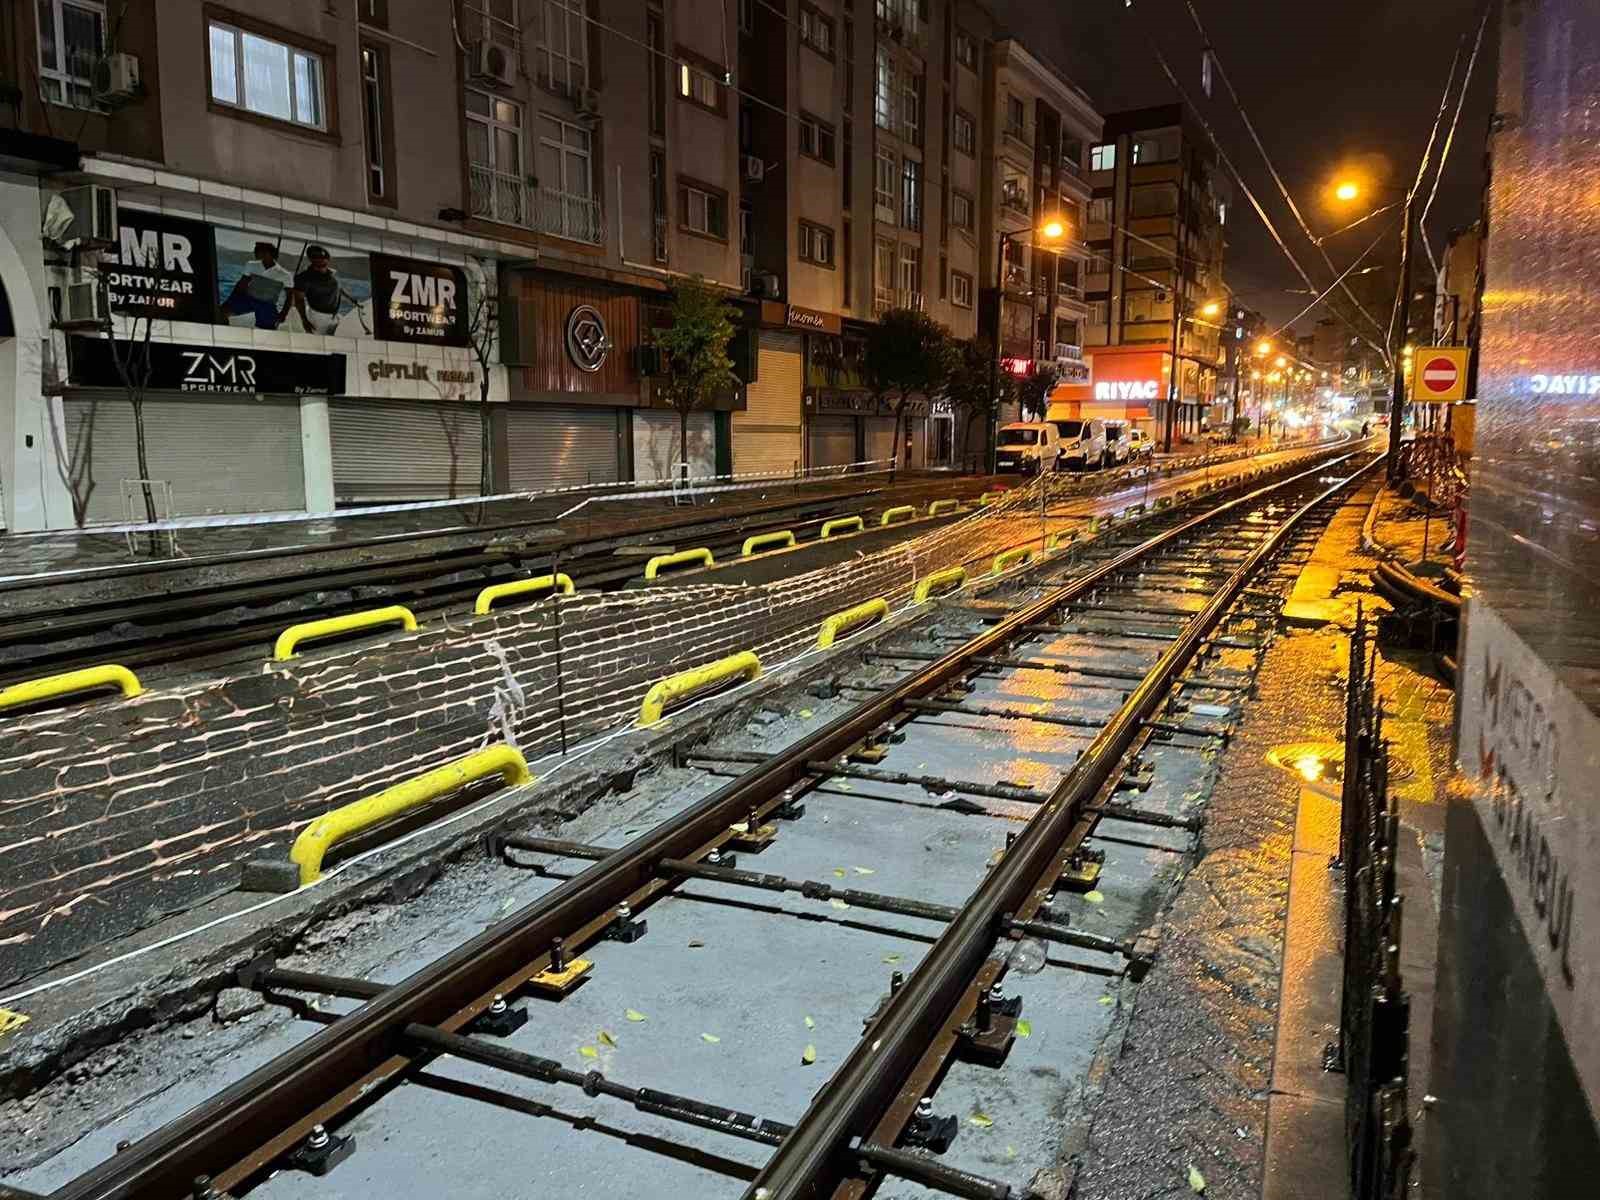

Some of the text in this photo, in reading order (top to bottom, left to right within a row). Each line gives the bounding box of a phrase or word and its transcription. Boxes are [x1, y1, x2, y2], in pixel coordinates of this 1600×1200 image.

[108, 272, 193, 294] ORTWEAR
[390, 270, 456, 310] ZMR
[182, 351, 256, 385] ZMR
[181, 383, 256, 394] SPORTWEAR
